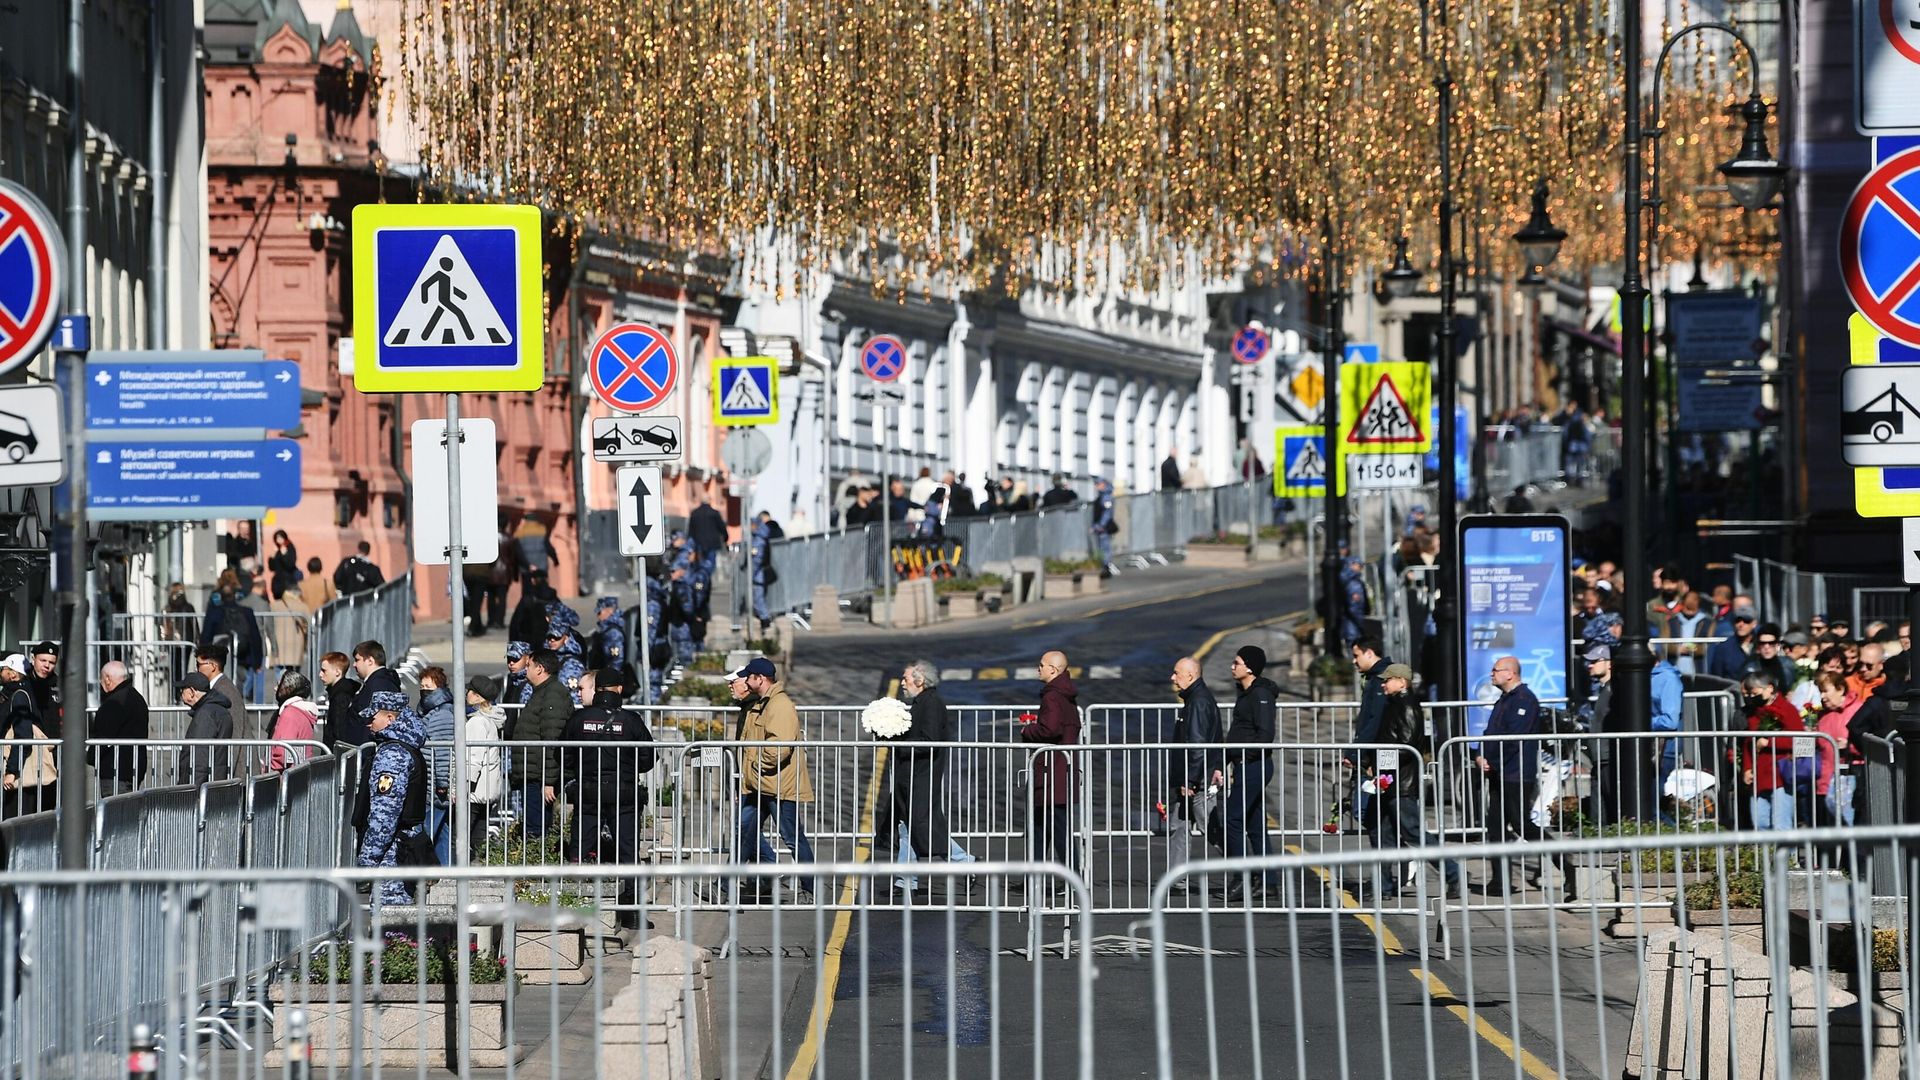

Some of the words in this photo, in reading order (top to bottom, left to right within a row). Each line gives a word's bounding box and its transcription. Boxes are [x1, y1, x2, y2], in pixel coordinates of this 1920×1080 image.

[121, 448, 156, 461] Музей
[156, 450, 209, 460] советских
[210, 450, 255, 460] игровых
[121, 461, 176, 471] автоматов
[1367, 464, 1396, 479] 150
[1531, 530, 1556, 542] ВТБ
[583, 723, 597, 732] МВД
